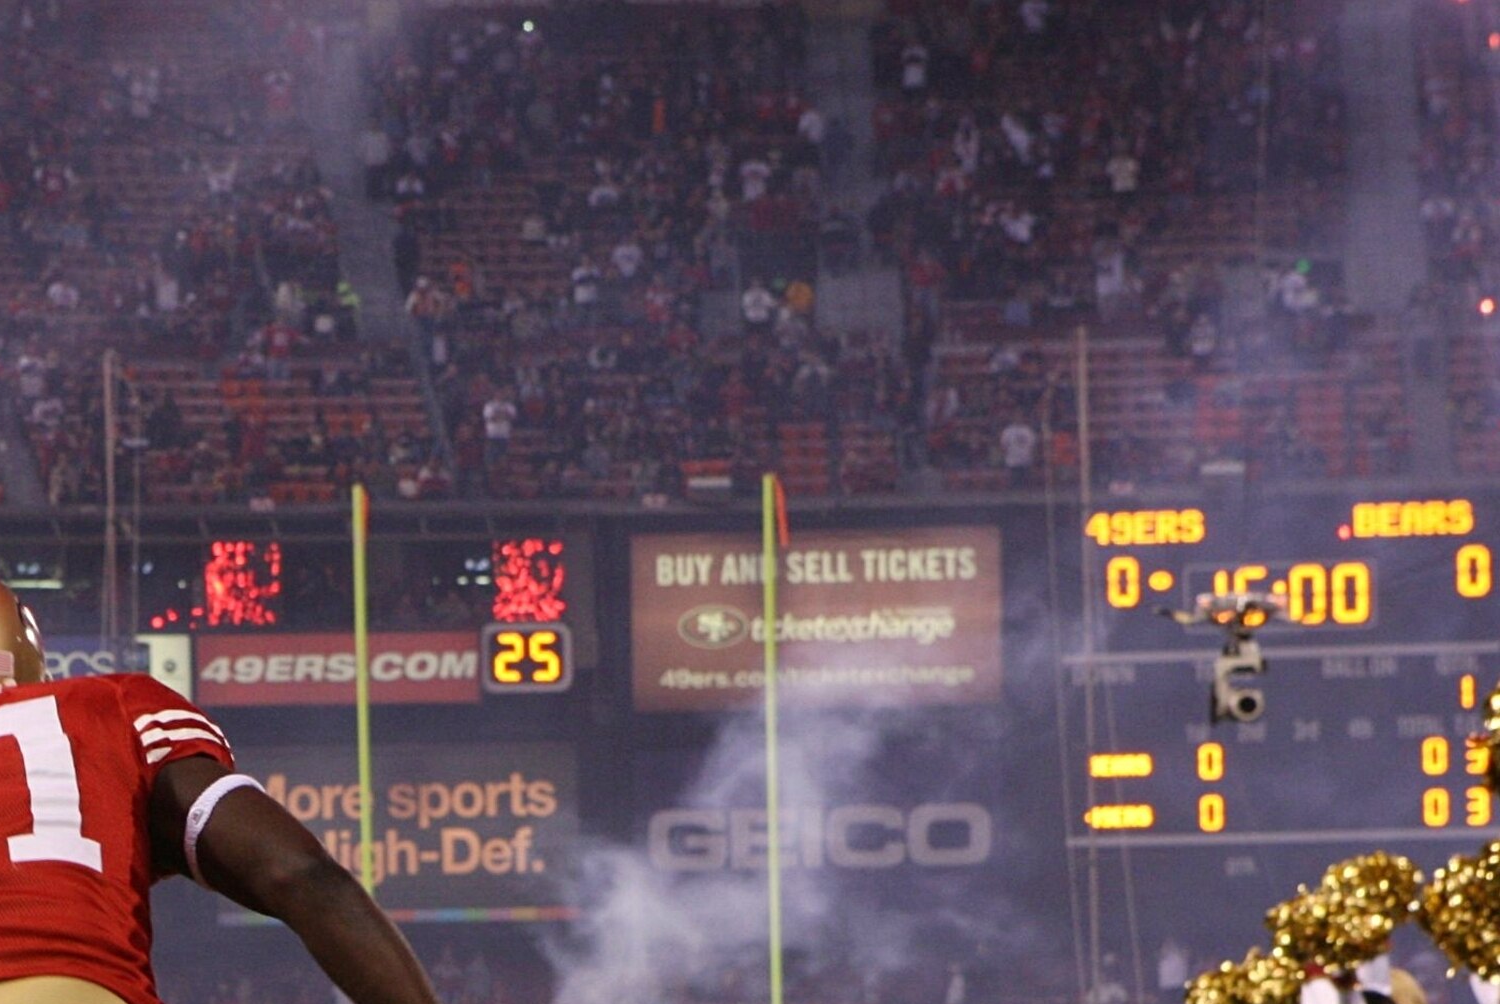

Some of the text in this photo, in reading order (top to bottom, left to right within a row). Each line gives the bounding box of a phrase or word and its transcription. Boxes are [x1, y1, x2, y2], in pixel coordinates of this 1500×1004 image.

[1085, 509, 1205, 545] 49ERS
[1352, 500, 1474, 537] BEARS
[656, 555, 712, 587] BUY
[786, 551, 854, 584] SELL
[861, 547, 977, 582] TICKETS
[1106, 556, 1140, 608] 0
[1455, 544, 1491, 598] 0
[751, 612, 955, 645] tcketexchange
[201, 651, 477, 684] 49ERSCOM
[494, 631, 561, 683] 25
[1197, 742, 1225, 781] 0
[1421, 736, 1449, 776] 0
[266, 772, 557, 829] ore sports
[1199, 793, 1226, 832] 0
[1423, 787, 1450, 827] 0
[1466, 786, 1491, 827] 3
[648, 803, 993, 872] GEICO
